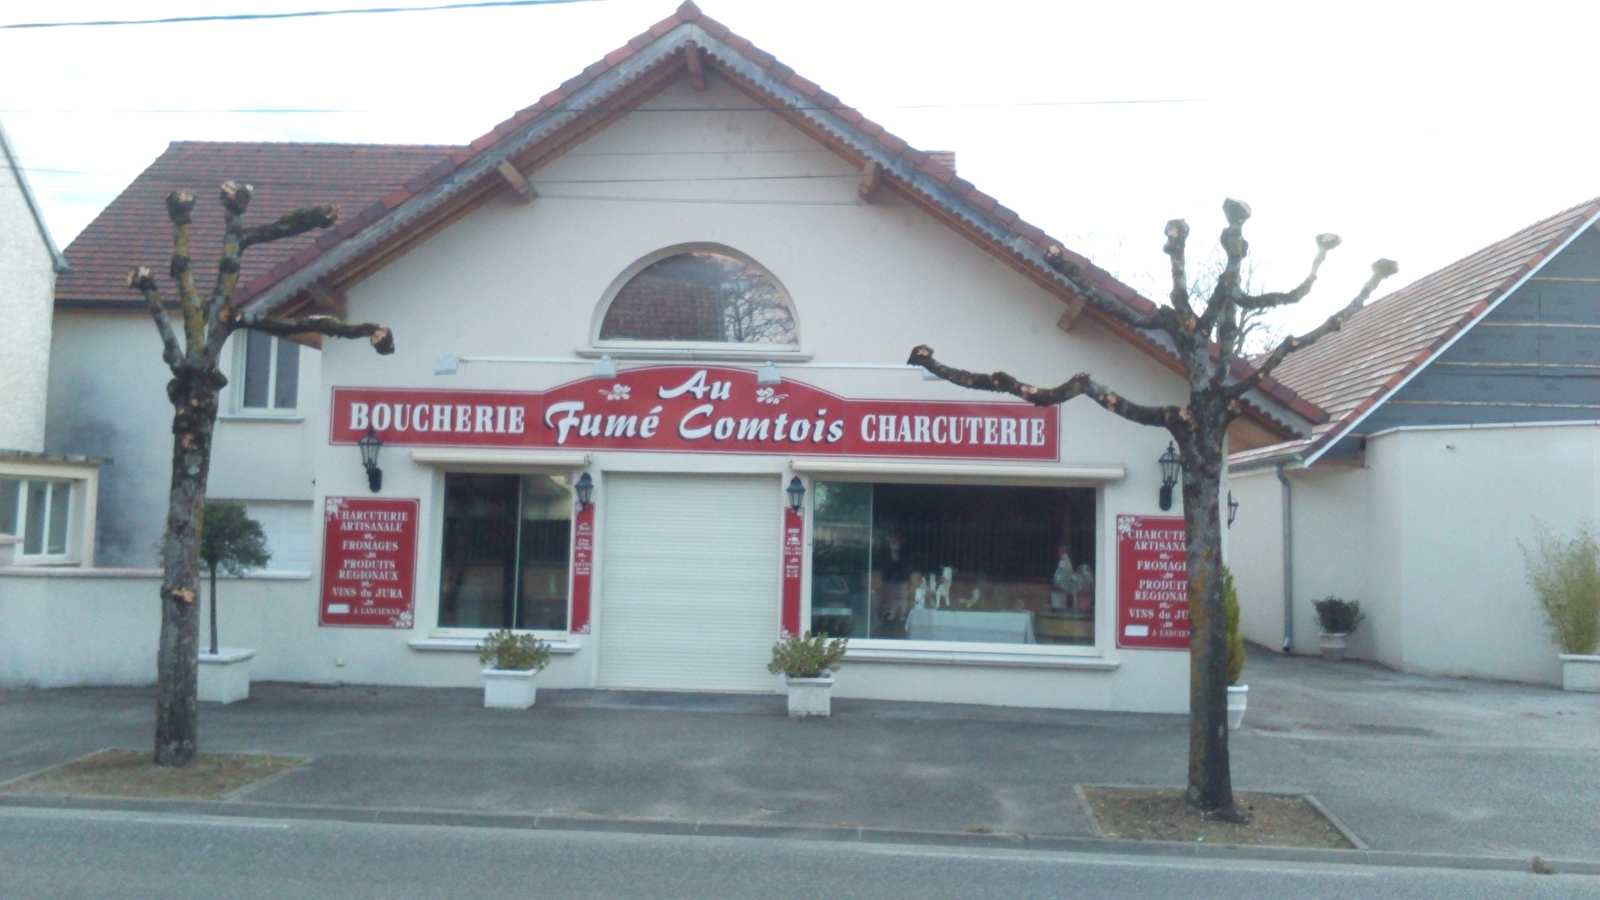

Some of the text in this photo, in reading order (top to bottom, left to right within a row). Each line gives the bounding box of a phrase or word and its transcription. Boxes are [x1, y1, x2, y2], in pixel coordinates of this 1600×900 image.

[658, 370, 732, 400] Au
[350, 403, 525, 434] BOUCHERIE
[544, 402, 844, 445] Fumé Comtois
[860, 414, 1046, 446] CHARCUTERIE
[335, 510, 408, 522] CHARCUTERIE
[340, 521, 402, 532] ARTISANALE
[1128, 529, 1186, 541] CHARCUTE
[342, 540, 399, 551] FROMAGES
[1133, 541, 1187, 552] ARTISANA
[343, 559, 396, 569] PRODUITS
[1136, 560, 1188, 571] FROMAGE
[1139, 580, 1188, 591] PRODUIT
[332, 587, 403, 599] VINS du JURA
[1128, 608, 1189, 620] VINS du JU
